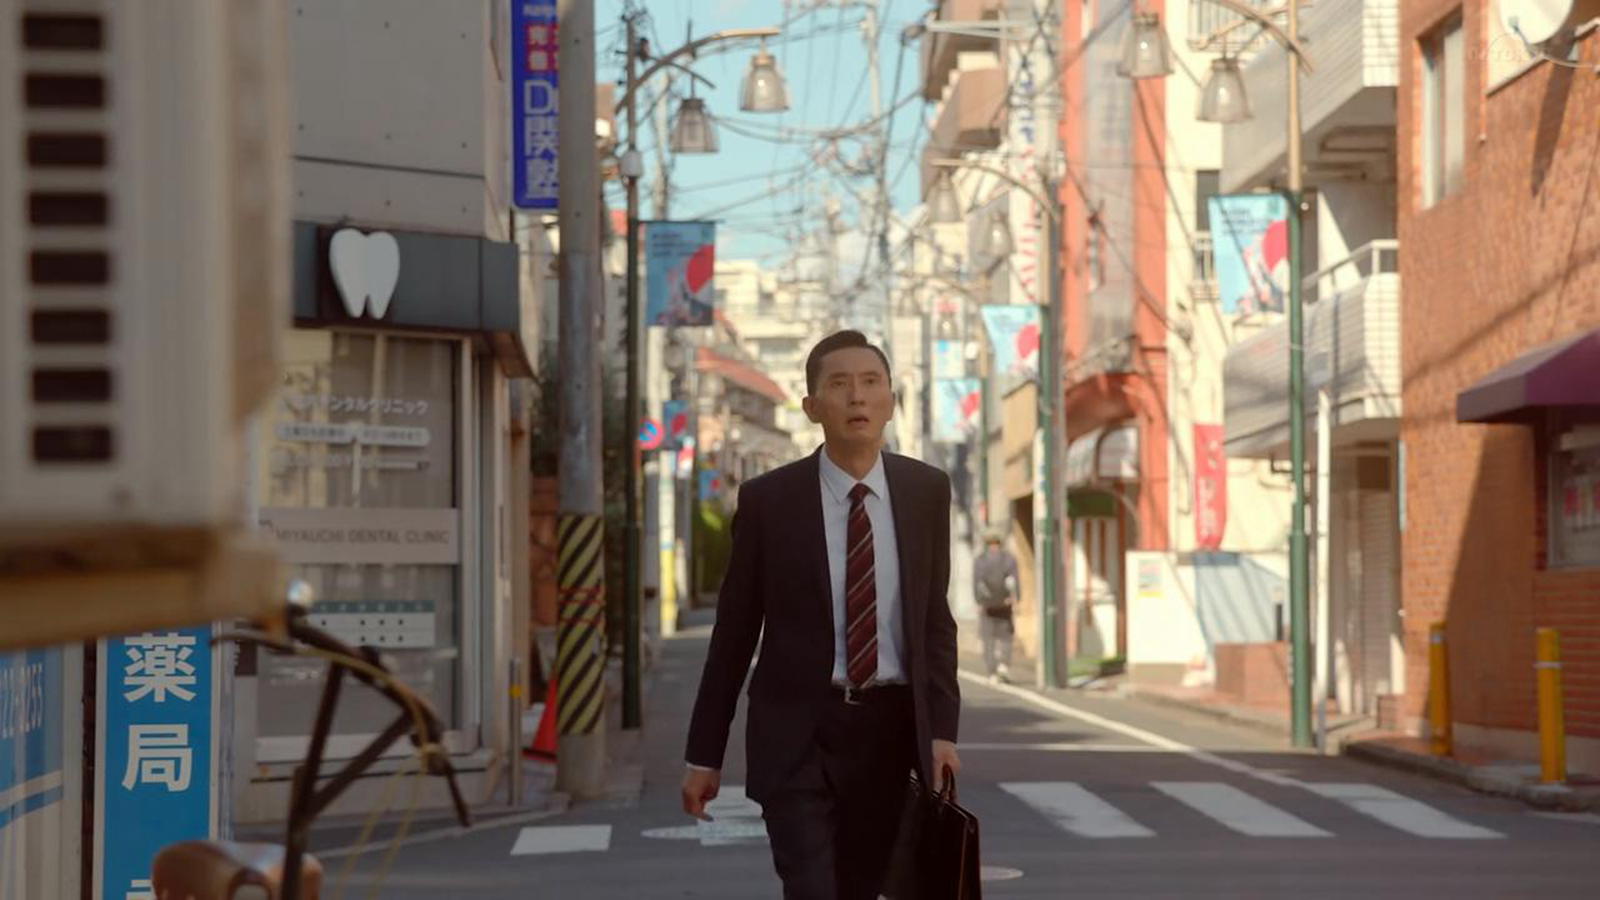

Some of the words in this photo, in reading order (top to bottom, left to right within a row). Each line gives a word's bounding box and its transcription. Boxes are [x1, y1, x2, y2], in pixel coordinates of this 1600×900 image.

[276, 529, 345, 543] MIYAUCHI
[348, 530, 401, 544] DENTAL
[405, 530, 450, 545] CLINIC
[121, 632, 197, 792] 薬局
